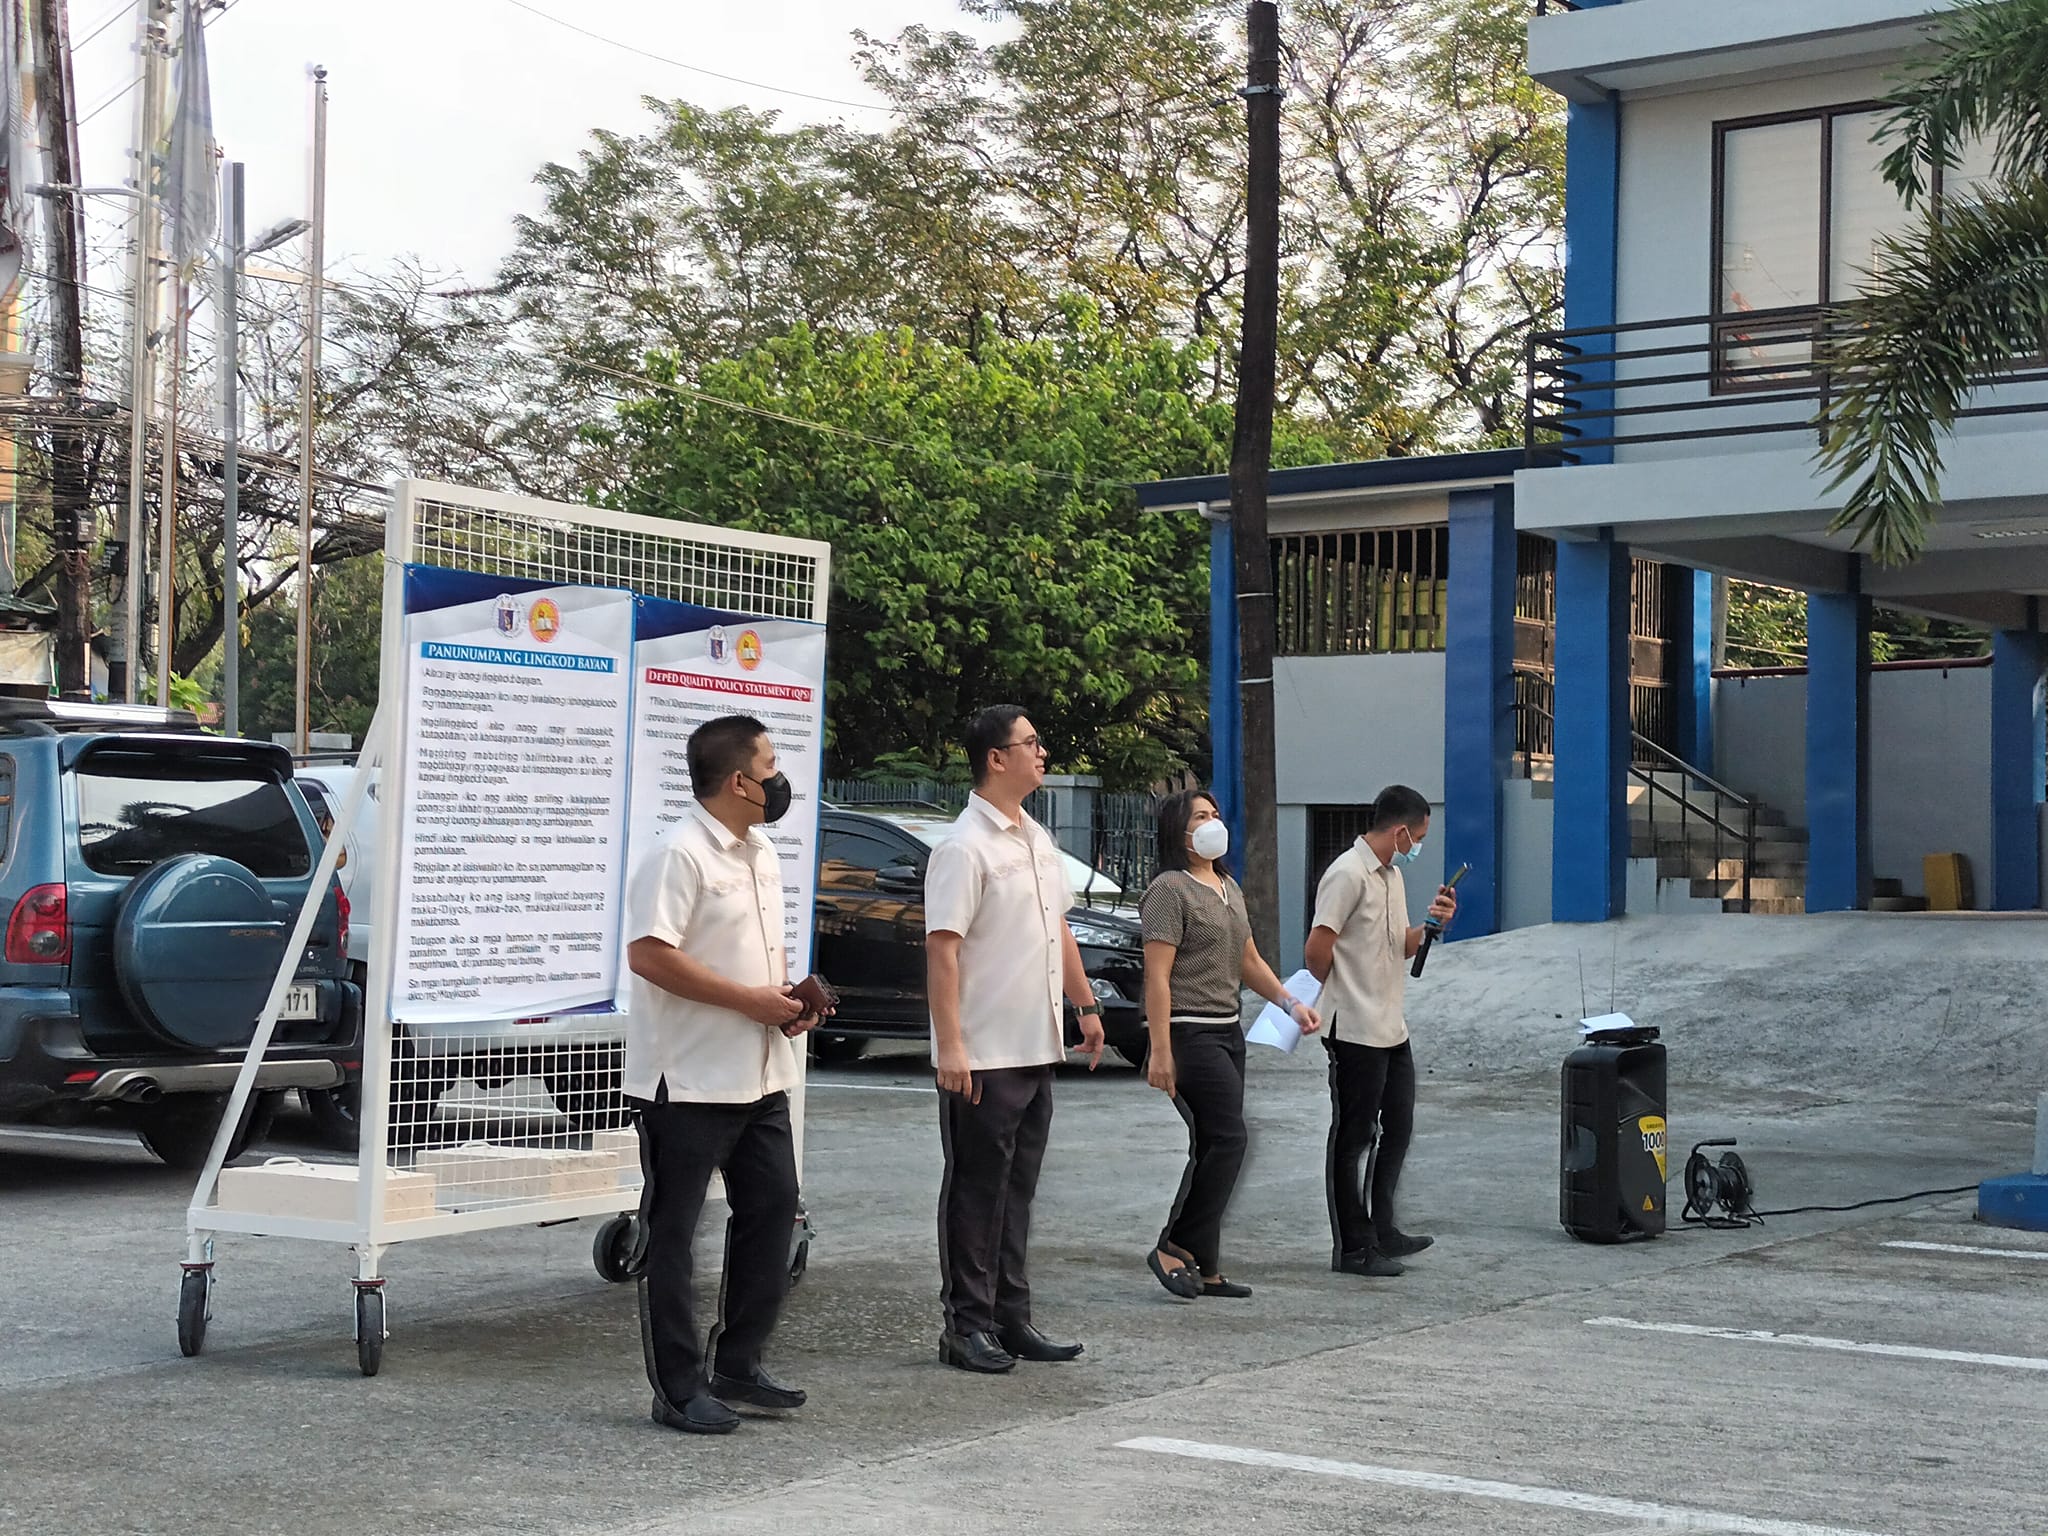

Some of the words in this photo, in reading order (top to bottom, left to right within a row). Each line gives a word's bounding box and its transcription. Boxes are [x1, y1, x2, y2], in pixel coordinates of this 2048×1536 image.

[428, 644, 501, 662] PANUNUMPA
[503, 651, 521, 663] NG
[524, 652, 575, 668] LINGKOD
[577, 657, 609, 671] BAYAN
[680, 674, 714, 689] QUALITY
[716, 679, 743, 693] POLICY
[744, 683, 790, 697] STATEMENT
[286, 992, 310, 1012] 171
